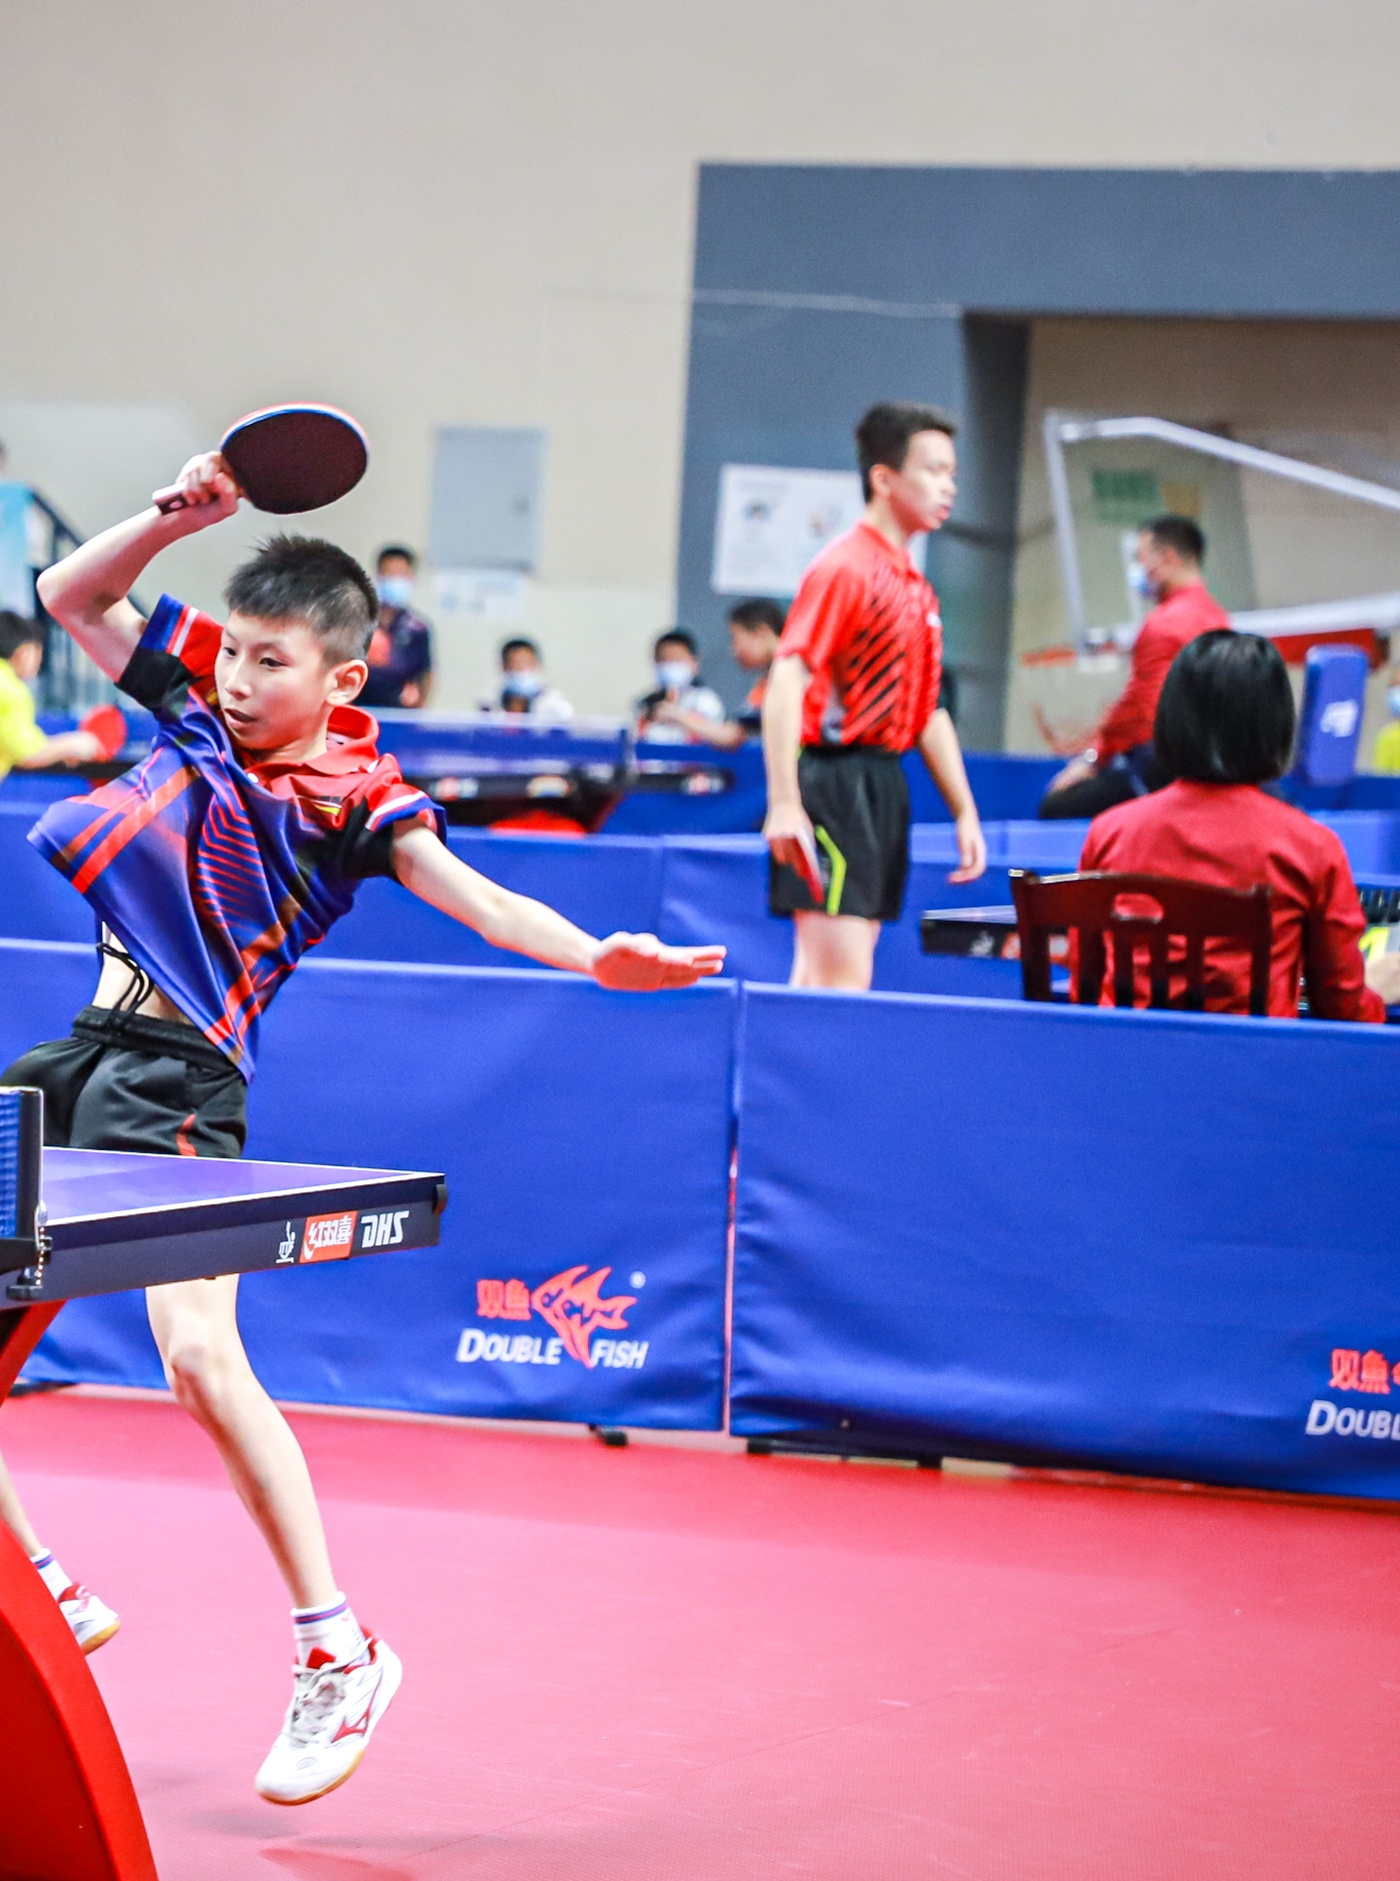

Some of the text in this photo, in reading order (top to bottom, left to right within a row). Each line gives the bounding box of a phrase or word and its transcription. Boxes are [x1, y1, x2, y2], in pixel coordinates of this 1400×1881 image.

[303, 1214, 352, 1260] 红双喜
[360, 1210, 410, 1248] DHS
[456, 1327, 650, 1370] DOUBLE FISH
